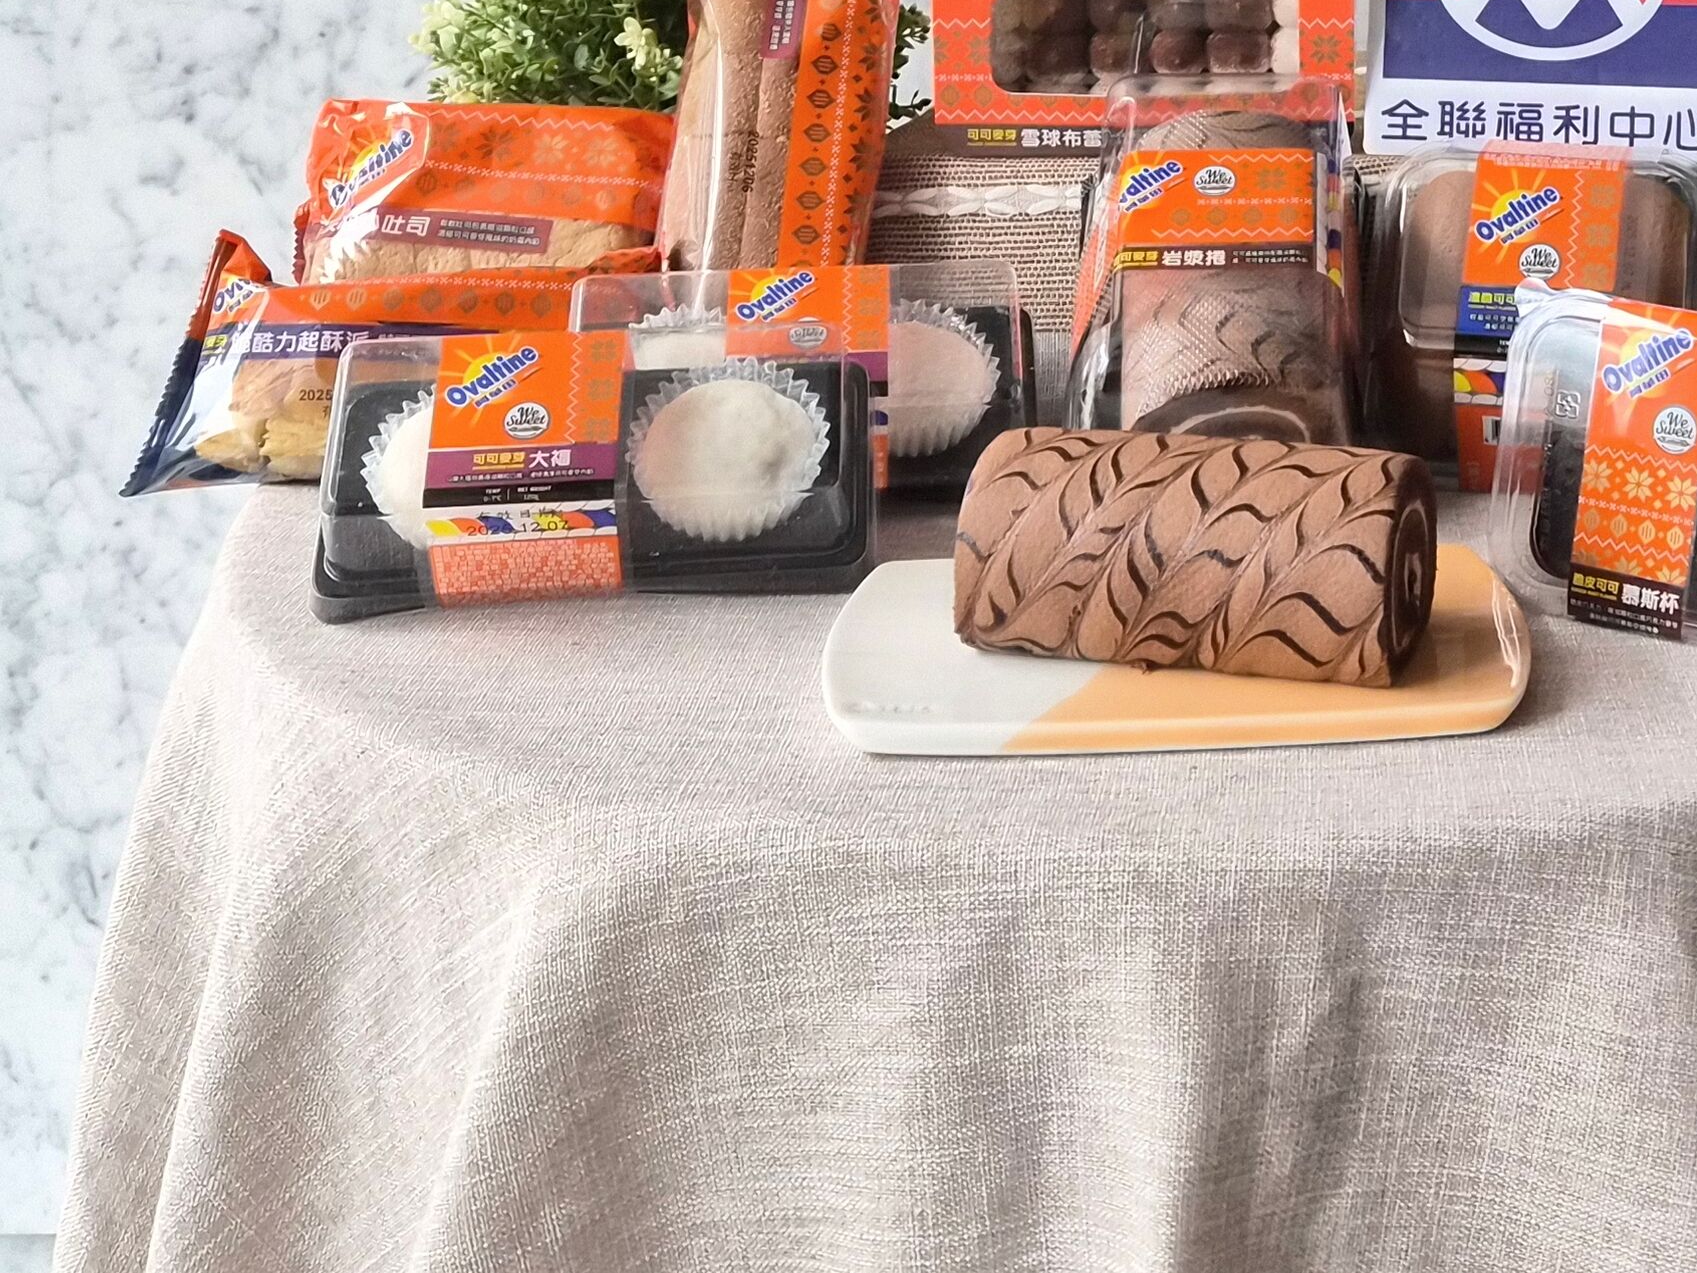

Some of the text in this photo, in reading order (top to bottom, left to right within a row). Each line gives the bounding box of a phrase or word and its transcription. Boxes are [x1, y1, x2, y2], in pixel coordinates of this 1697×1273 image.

[1119, 160, 1182, 205] valtine
[377, 215, 431, 237] 吐司
[1475, 187, 1558, 242] Ovaltine
[1530, 247, 1552, 260] We
[737, 271, 813, 320] Ovaltine
[447, 347, 537, 406] Ovaltine
[1603, 330, 1692, 393] Ovaltine
[1656, 421, 1694, 440] Sweet
[1667, 412, 1689, 429] We
[528, 448, 572, 469] 大福
[1621, 583, 1681, 616] 慕斯杯
